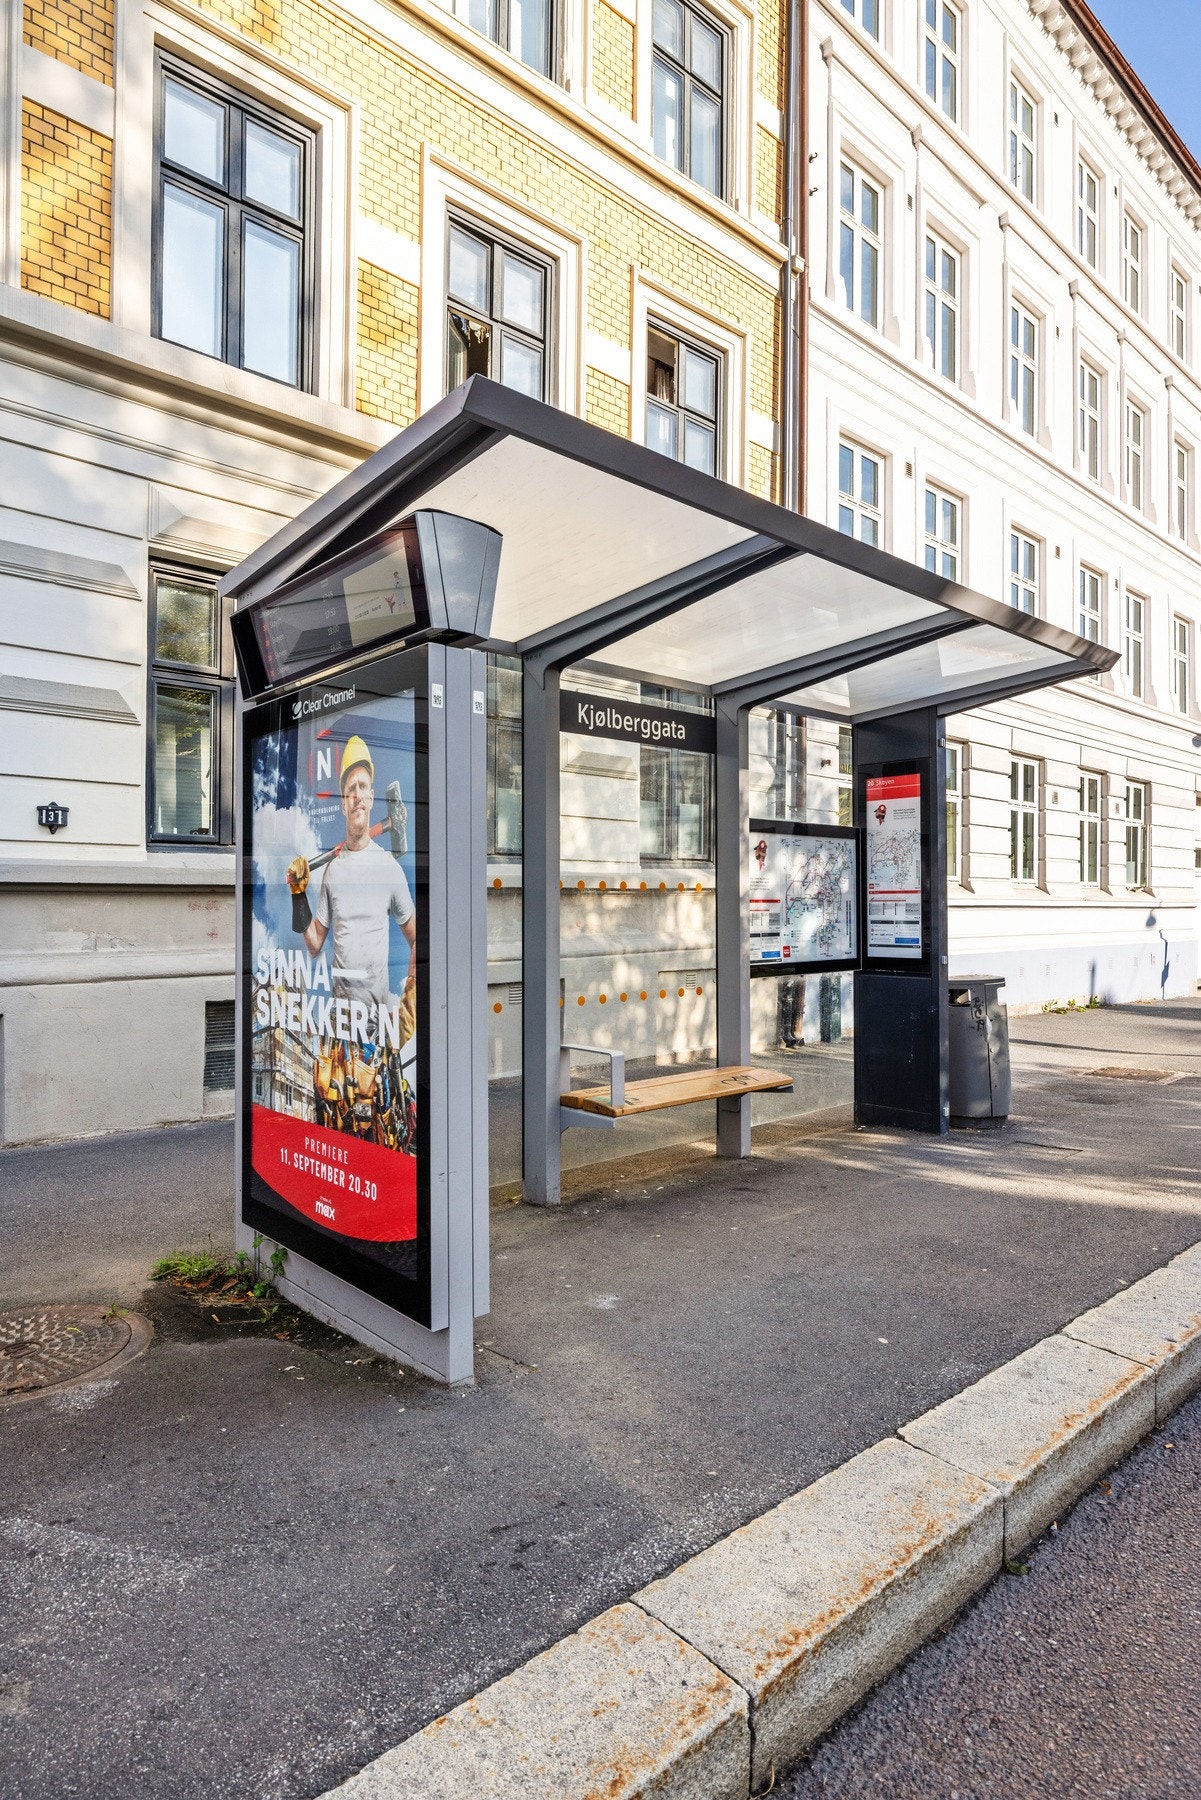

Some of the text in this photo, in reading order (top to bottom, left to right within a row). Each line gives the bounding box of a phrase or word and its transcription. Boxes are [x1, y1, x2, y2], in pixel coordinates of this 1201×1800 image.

[302, 684, 356, 715] Clear Channel
[578, 702, 686, 740] Kjølberggata
[317, 748, 332, 781] N
[875, 778, 895, 787] Skøyen
[304, 1137, 349, 1165] PREMIERE
[280, 1147, 377, 1202] 11. SEPTEMBER 20.30
[315, 1200, 336, 1221] max
